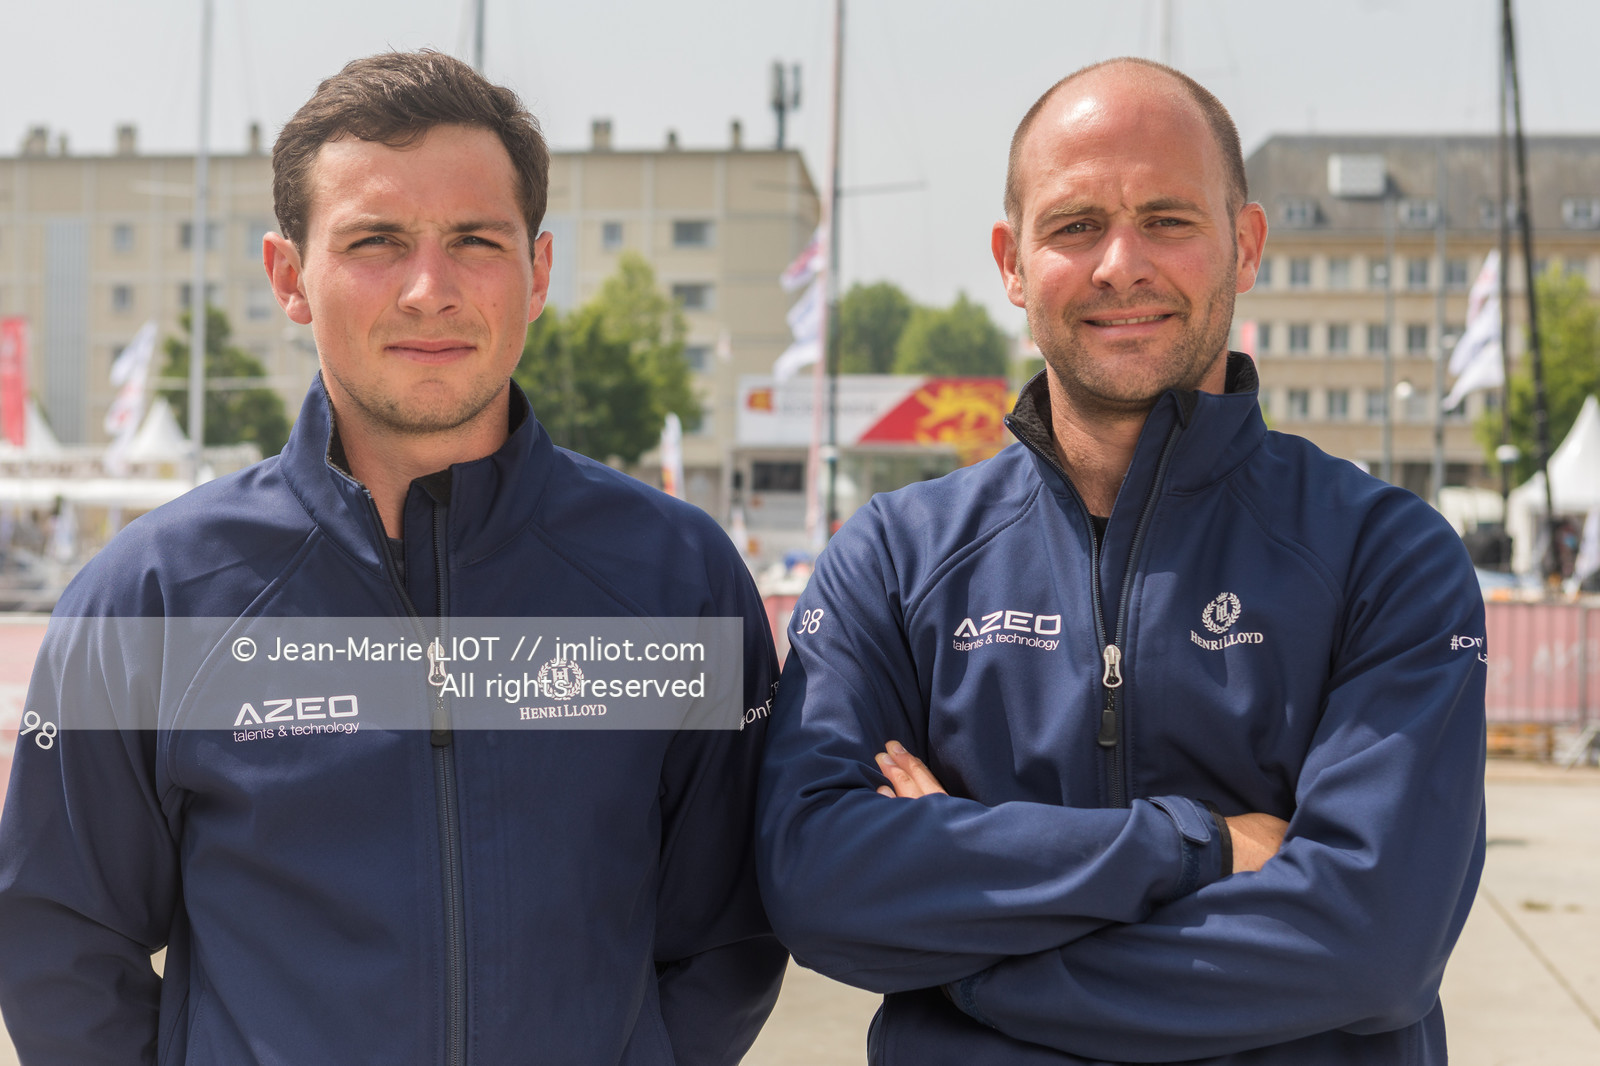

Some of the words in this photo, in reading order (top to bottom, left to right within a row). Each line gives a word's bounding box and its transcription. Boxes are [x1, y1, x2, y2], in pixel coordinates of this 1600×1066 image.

[796, 608, 824, 634] 98
[953, 610, 1061, 637] AZEO
[953, 639, 984, 651] talents
[985, 633, 993, 645] &
[995, 633, 1060, 651] technology
[1450, 634, 1484, 650] #On
[233, 694, 359, 727] AZEO
[20, 710, 58, 750] 98
[232, 724, 275, 743] talents
[277, 725, 288, 738] &
[290, 720, 360, 736] technology
